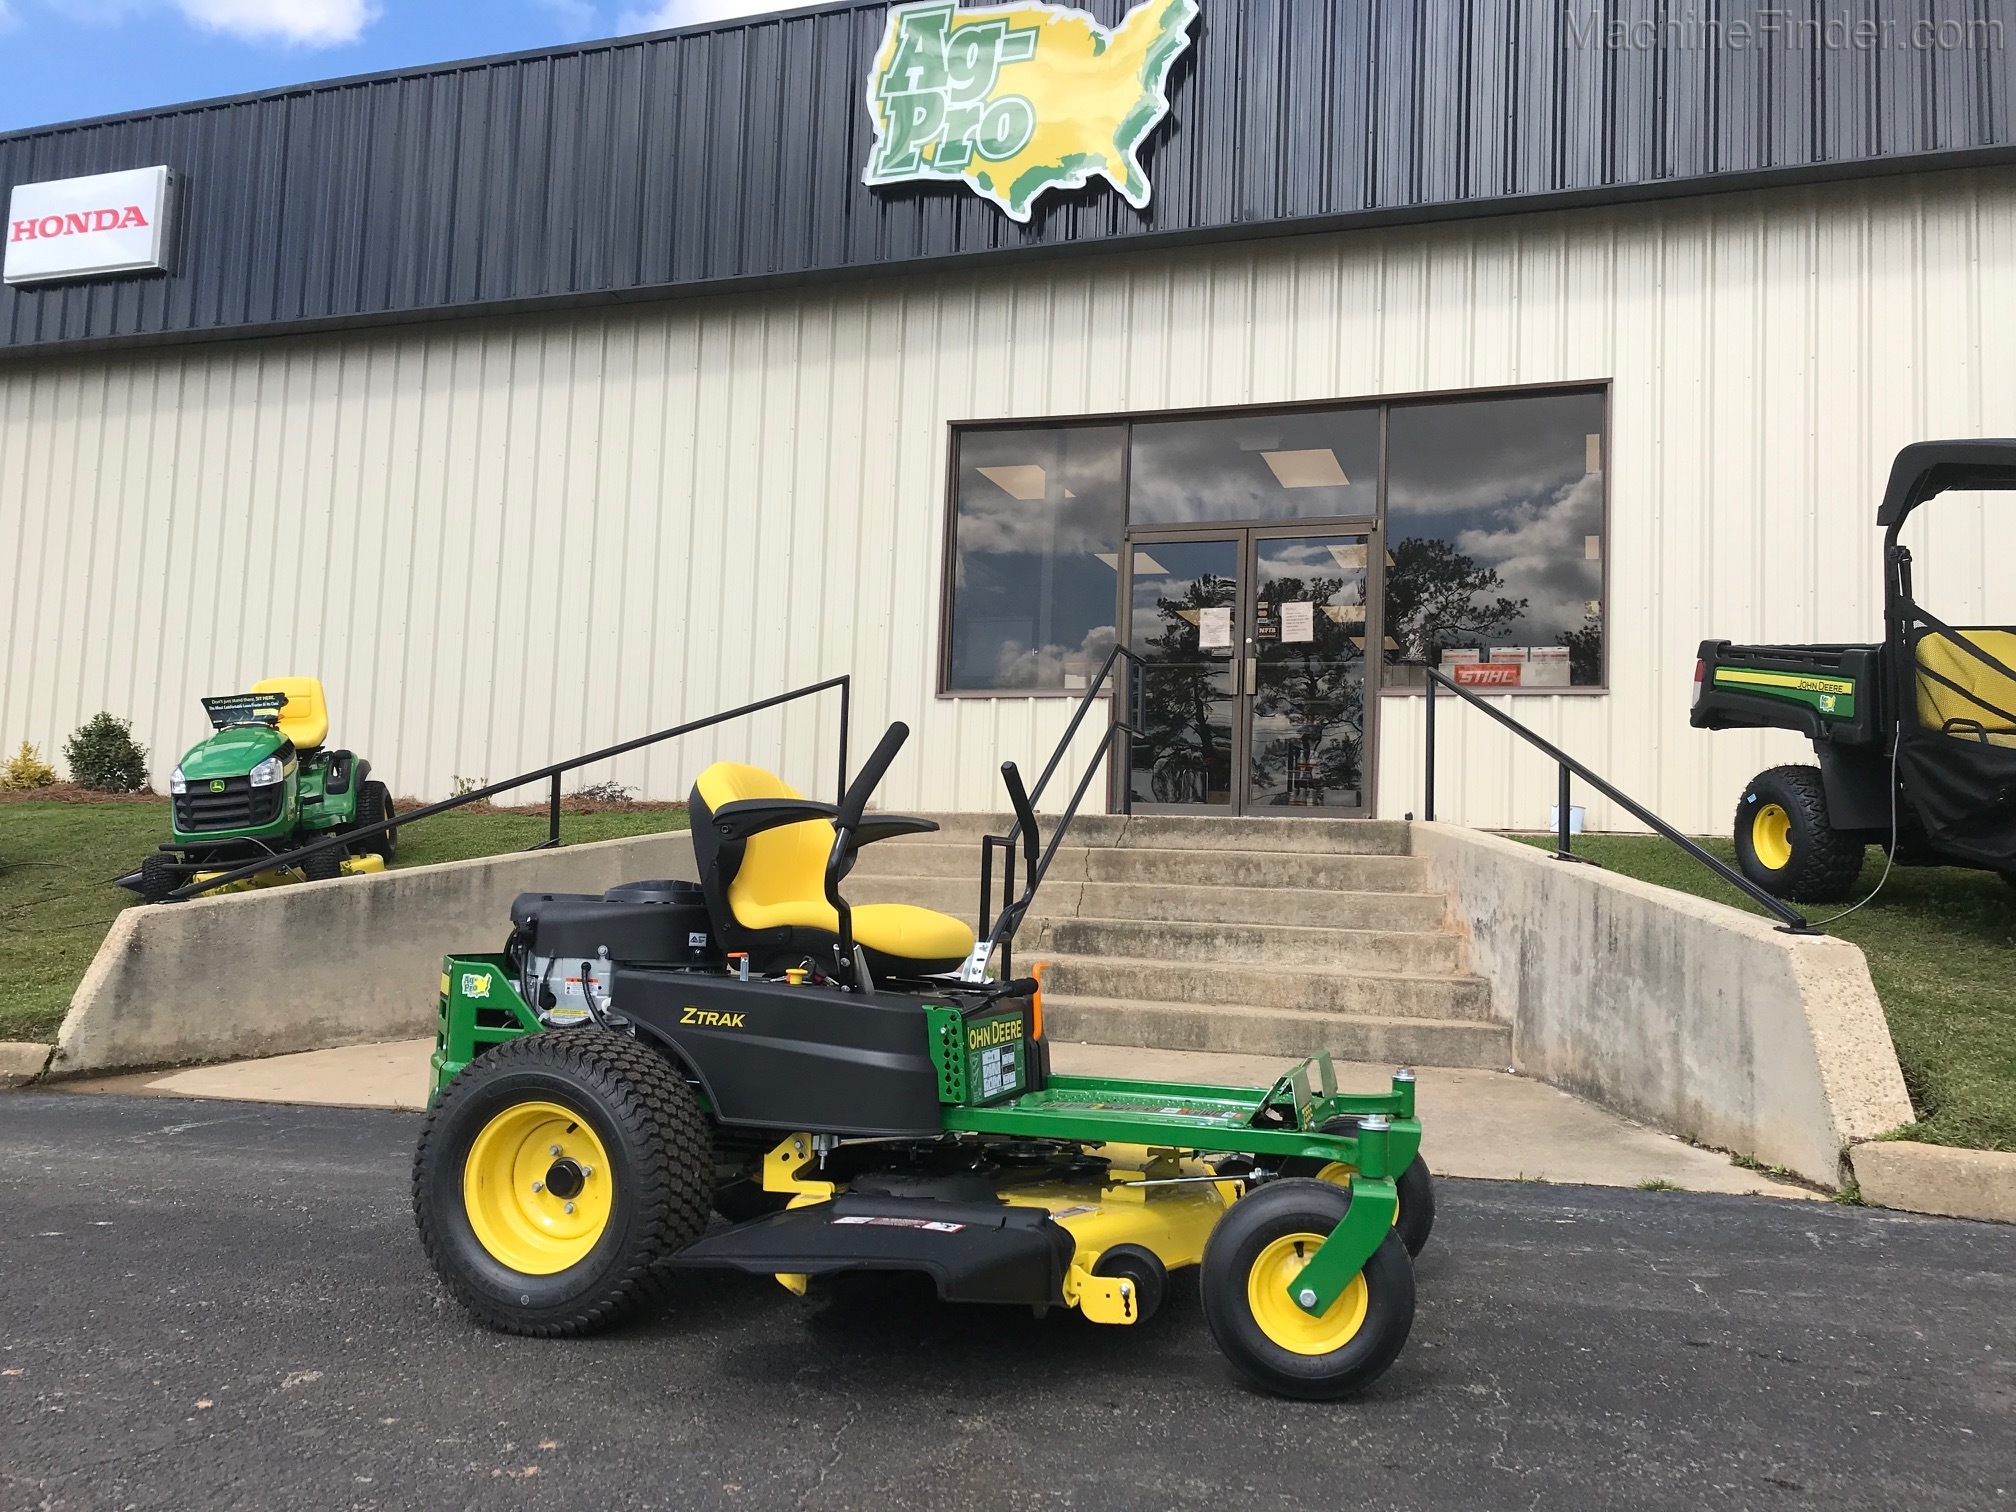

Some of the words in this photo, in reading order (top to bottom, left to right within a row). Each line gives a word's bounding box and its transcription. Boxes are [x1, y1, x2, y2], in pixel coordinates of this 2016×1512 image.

[879, 3, 1039, 105] Ag-
[874, 93, 1036, 176] Pro
[10, 205, 149, 242] HONDA
[1458, 670, 1516, 683] STIHL
[1797, 679, 1818, 690] JOHN
[1818, 681, 1844, 693] DEERE
[680, 1007, 746, 1028] ZTRAK
[991, 1019, 1022, 1045] DEERE
